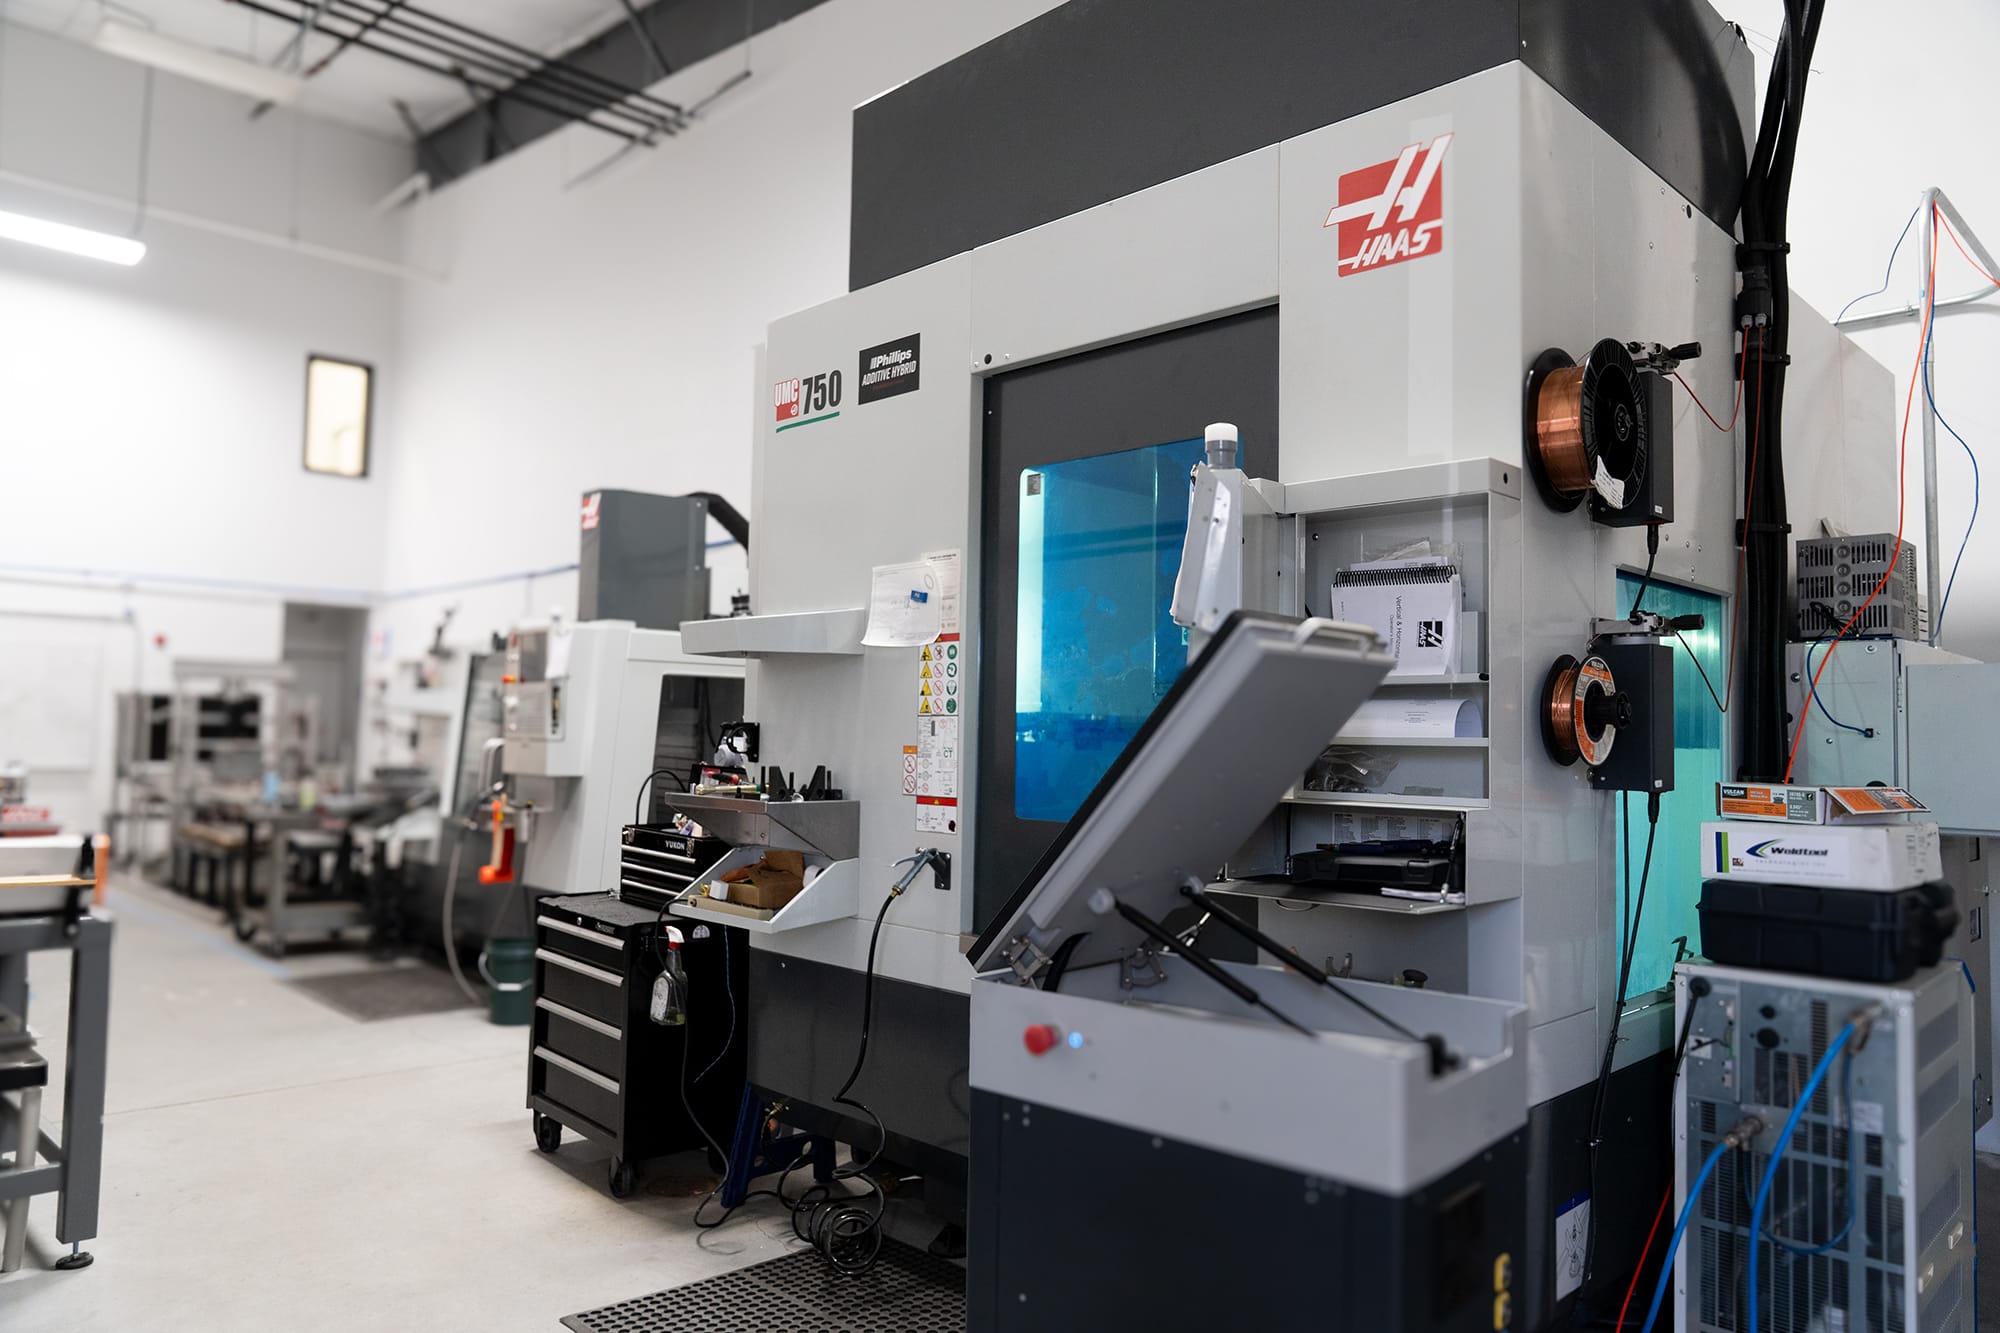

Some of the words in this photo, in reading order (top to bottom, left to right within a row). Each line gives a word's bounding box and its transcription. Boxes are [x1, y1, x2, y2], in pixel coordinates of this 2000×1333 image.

[1338, 218, 1443, 269] HAAS
[876, 349, 912, 367] Phillips
[862, 367, 891, 386] ADDITIVE
[891, 360, 917, 379] HYBRID
[775, 378, 799, 407] UMC
[803, 370, 842, 415] 750
[664, 840, 686, 850] YUKON
